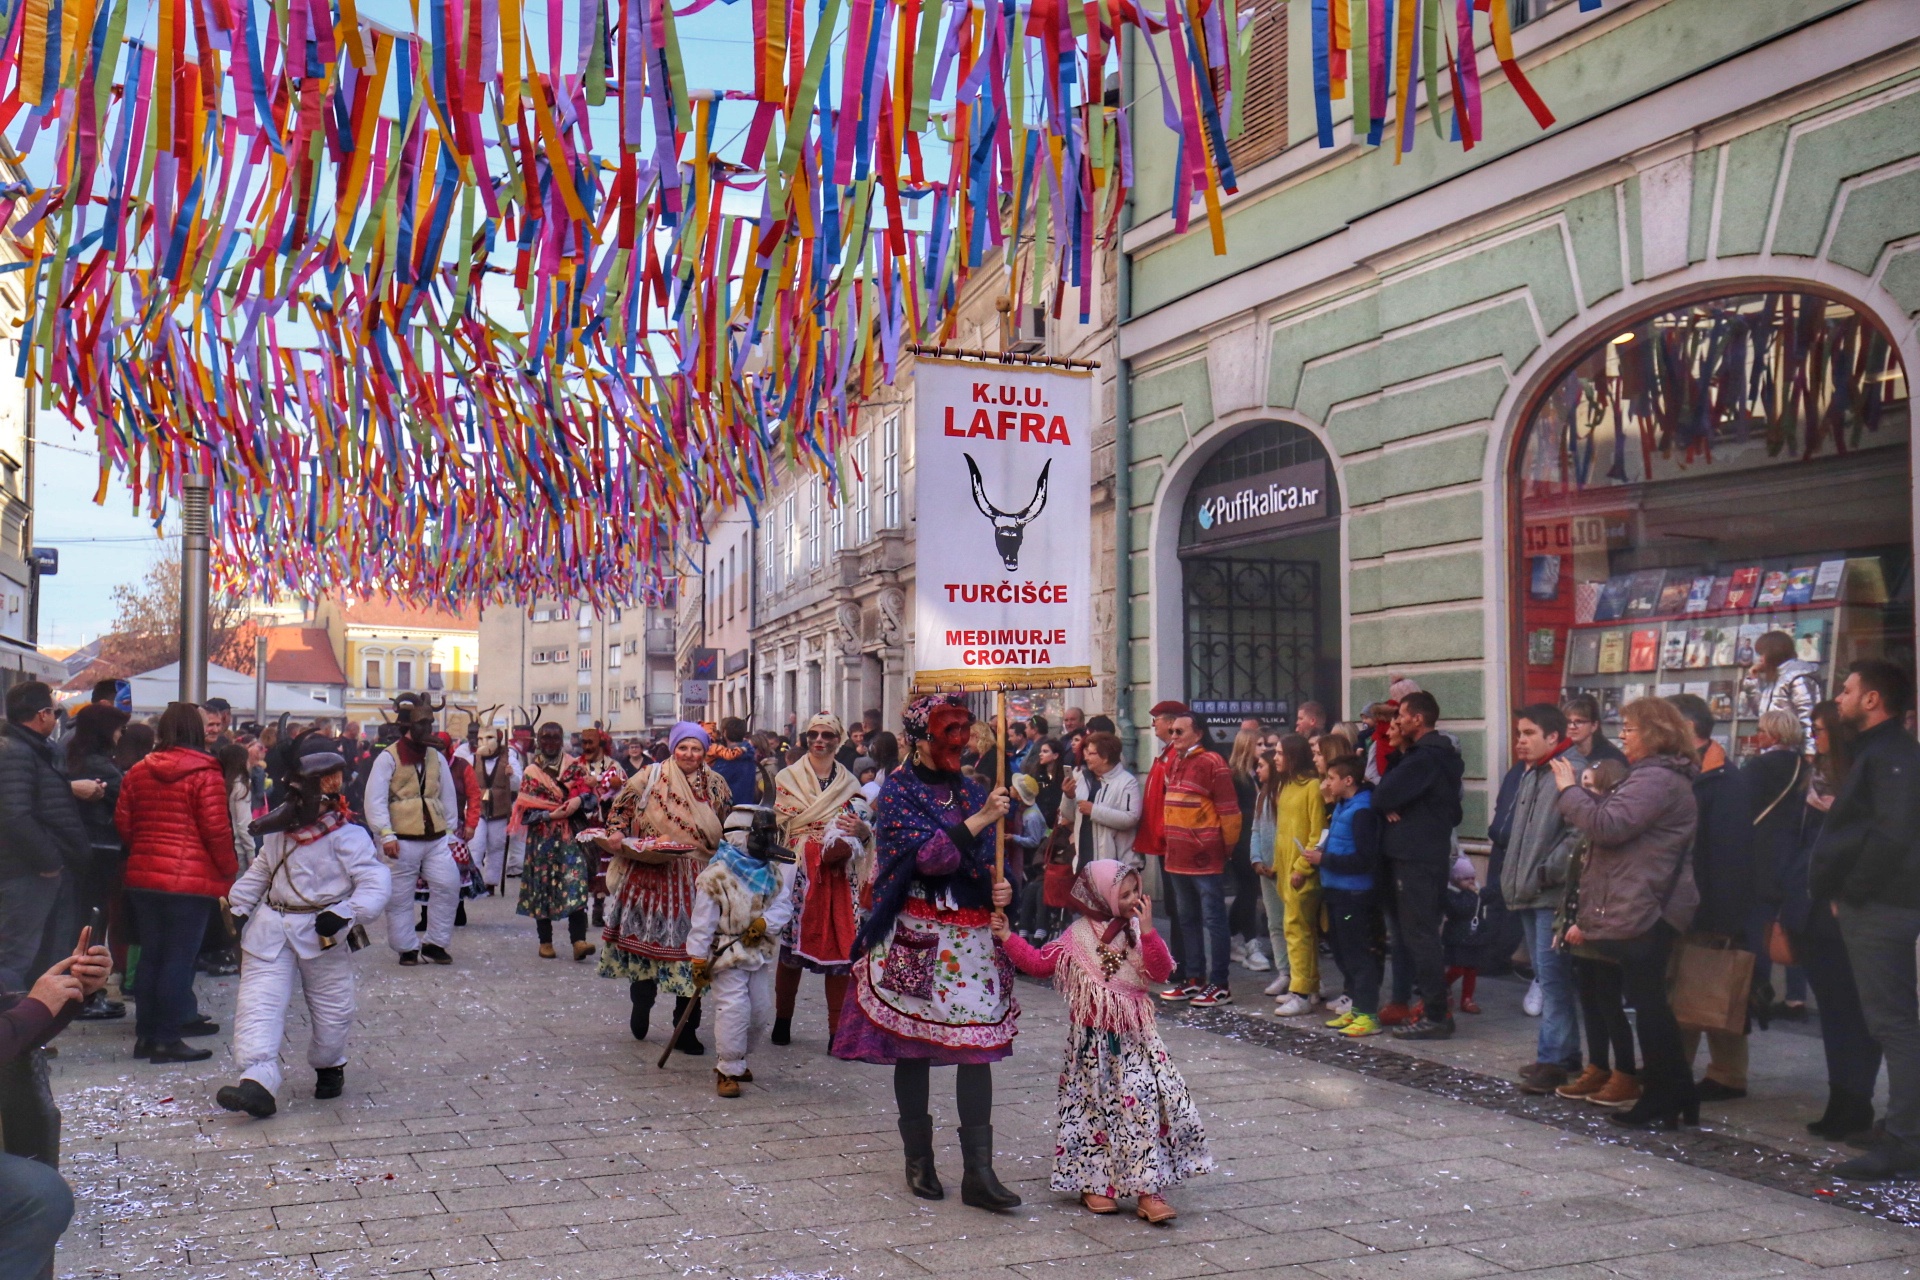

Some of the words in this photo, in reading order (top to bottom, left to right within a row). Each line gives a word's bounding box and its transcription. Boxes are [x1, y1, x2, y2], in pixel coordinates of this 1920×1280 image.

[972, 383, 1049, 407] K.U.U.
[944, 407, 1071, 445] LAFRA
[1217, 484, 1319, 525] Puffkalica.hr
[944, 580, 1068, 604] TURČIŠĆE
[945, 628, 1066, 646] MEĐIMURJE
[962, 648, 1051, 666] CROATIA
